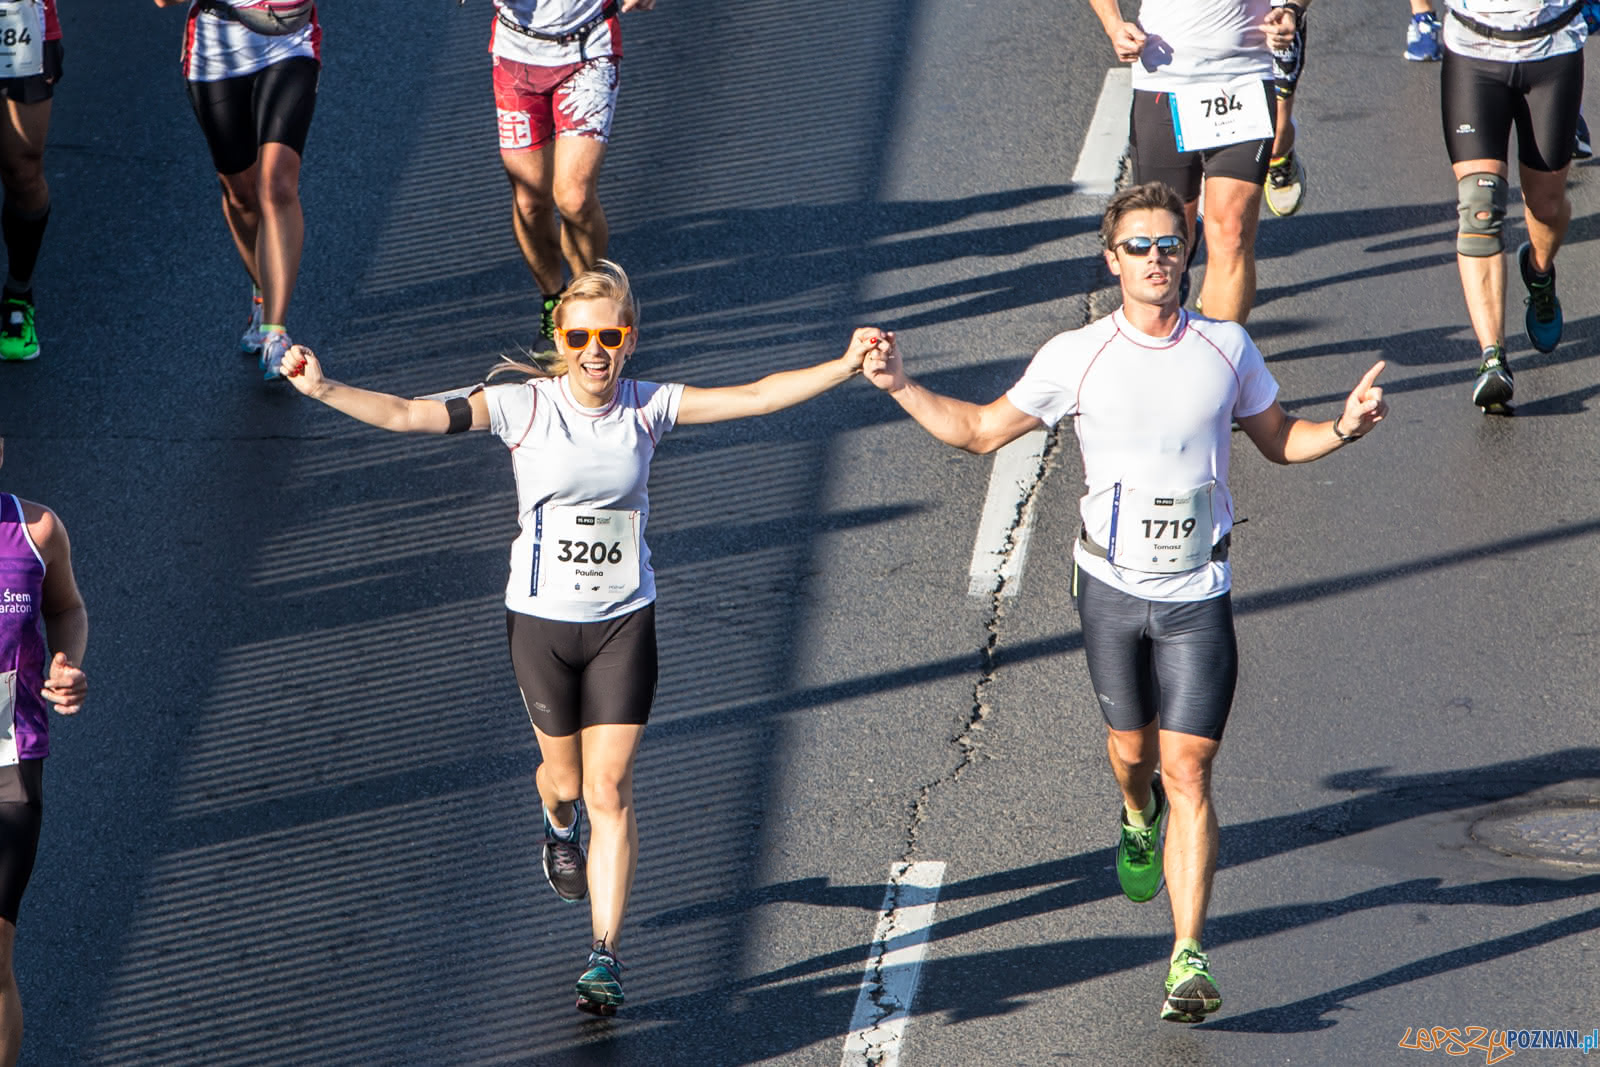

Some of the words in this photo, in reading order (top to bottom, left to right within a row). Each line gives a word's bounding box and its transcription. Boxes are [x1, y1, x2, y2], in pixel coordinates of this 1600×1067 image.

[0, 27, 32, 47] 84
[1200, 94, 1243, 118] 784
[1141, 517, 1197, 539] 1719
[557, 539, 622, 565] 3206
[575, 569, 604, 577] Paulina
[3, 588, 31, 602] Śrem
